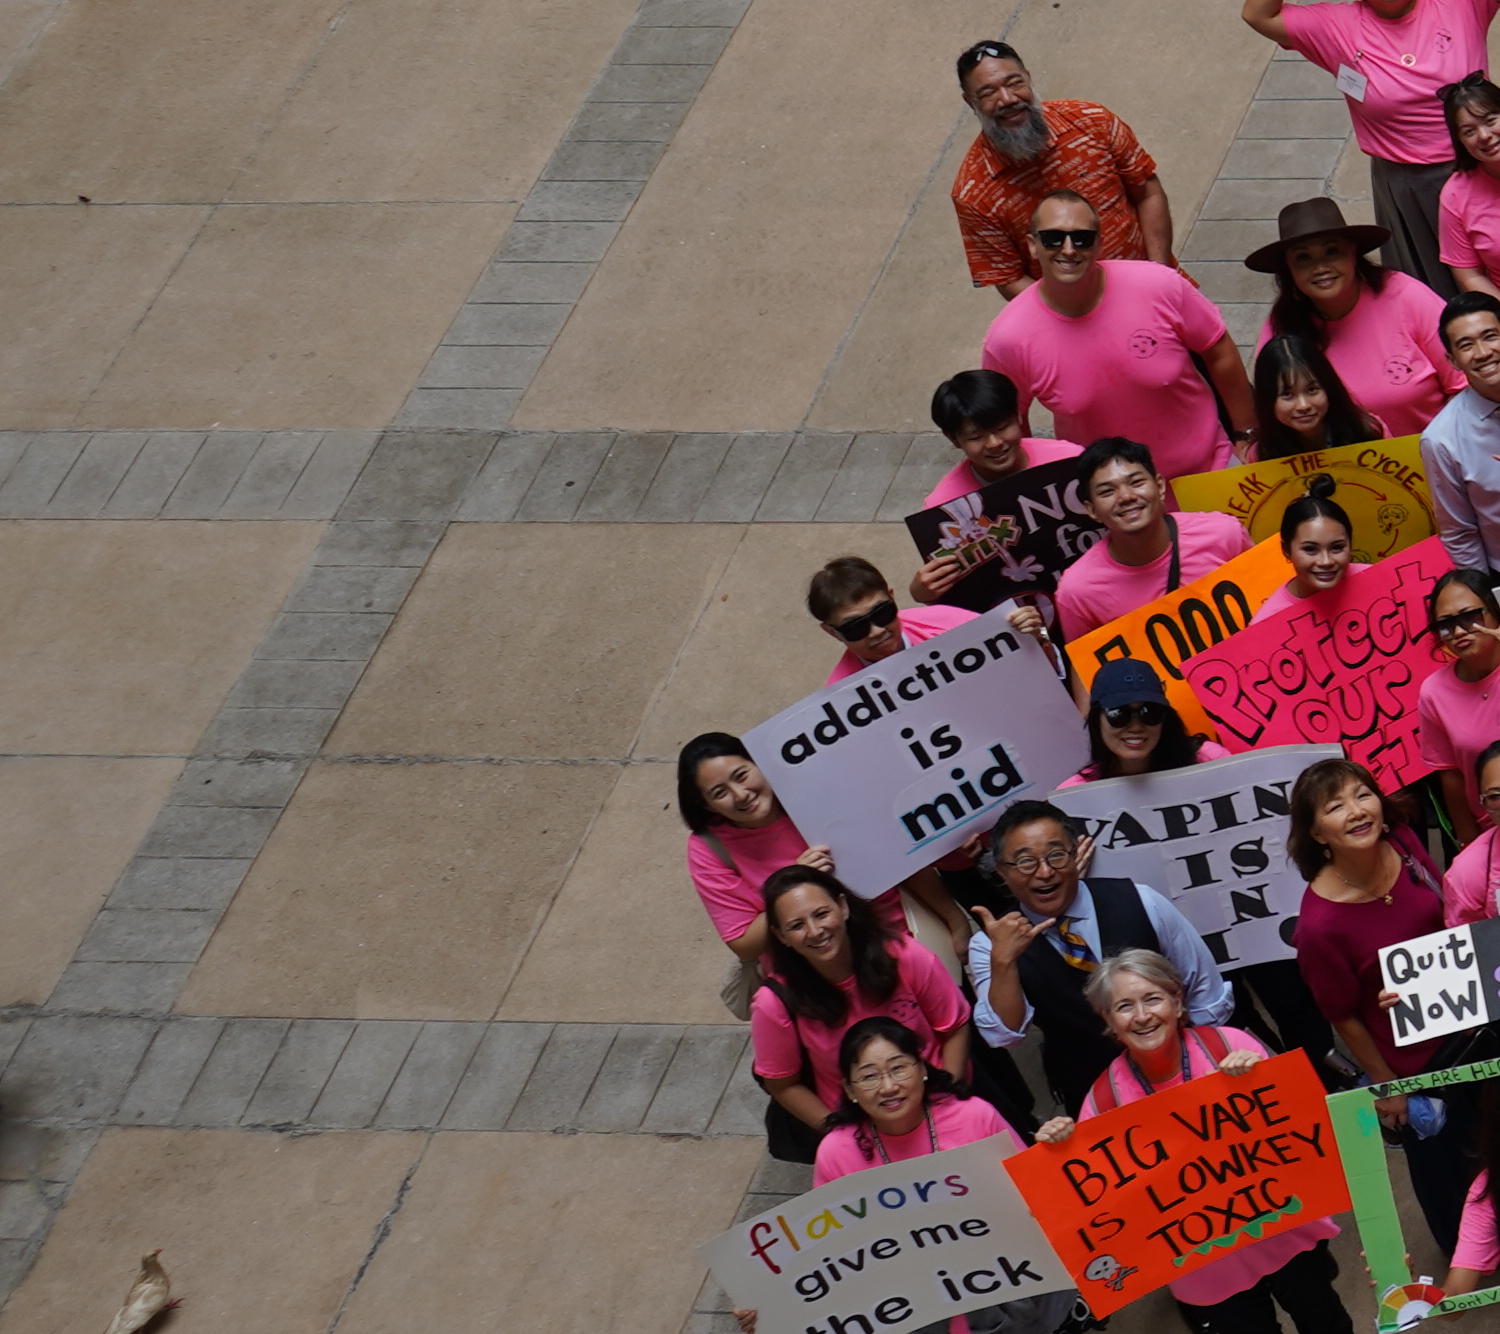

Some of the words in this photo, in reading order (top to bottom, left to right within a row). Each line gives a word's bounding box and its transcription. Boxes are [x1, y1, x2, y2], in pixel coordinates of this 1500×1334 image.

[1282, 450, 1327, 478] THE
[1357, 448, 1426, 491] CYCLE
[780, 629, 1021, 765] addiction
[901, 719, 963, 770] is
[901, 744, 1025, 845] mid
[1386, 934, 1474, 985] Quit
[1062, 1125, 1168, 1208] BIG
[1171, 1084, 1291, 1142] VAPE
[1077, 1212, 1126, 1254] IS
[1146, 1122, 1326, 1215] LOWKEY
[750, 1173, 969, 1276] flavors
[795, 1235, 902, 1303] give
[910, 1218, 991, 1250] me
[1147, 1177, 1295, 1260] TOXIC
[938, 1256, 1045, 1302] ick
